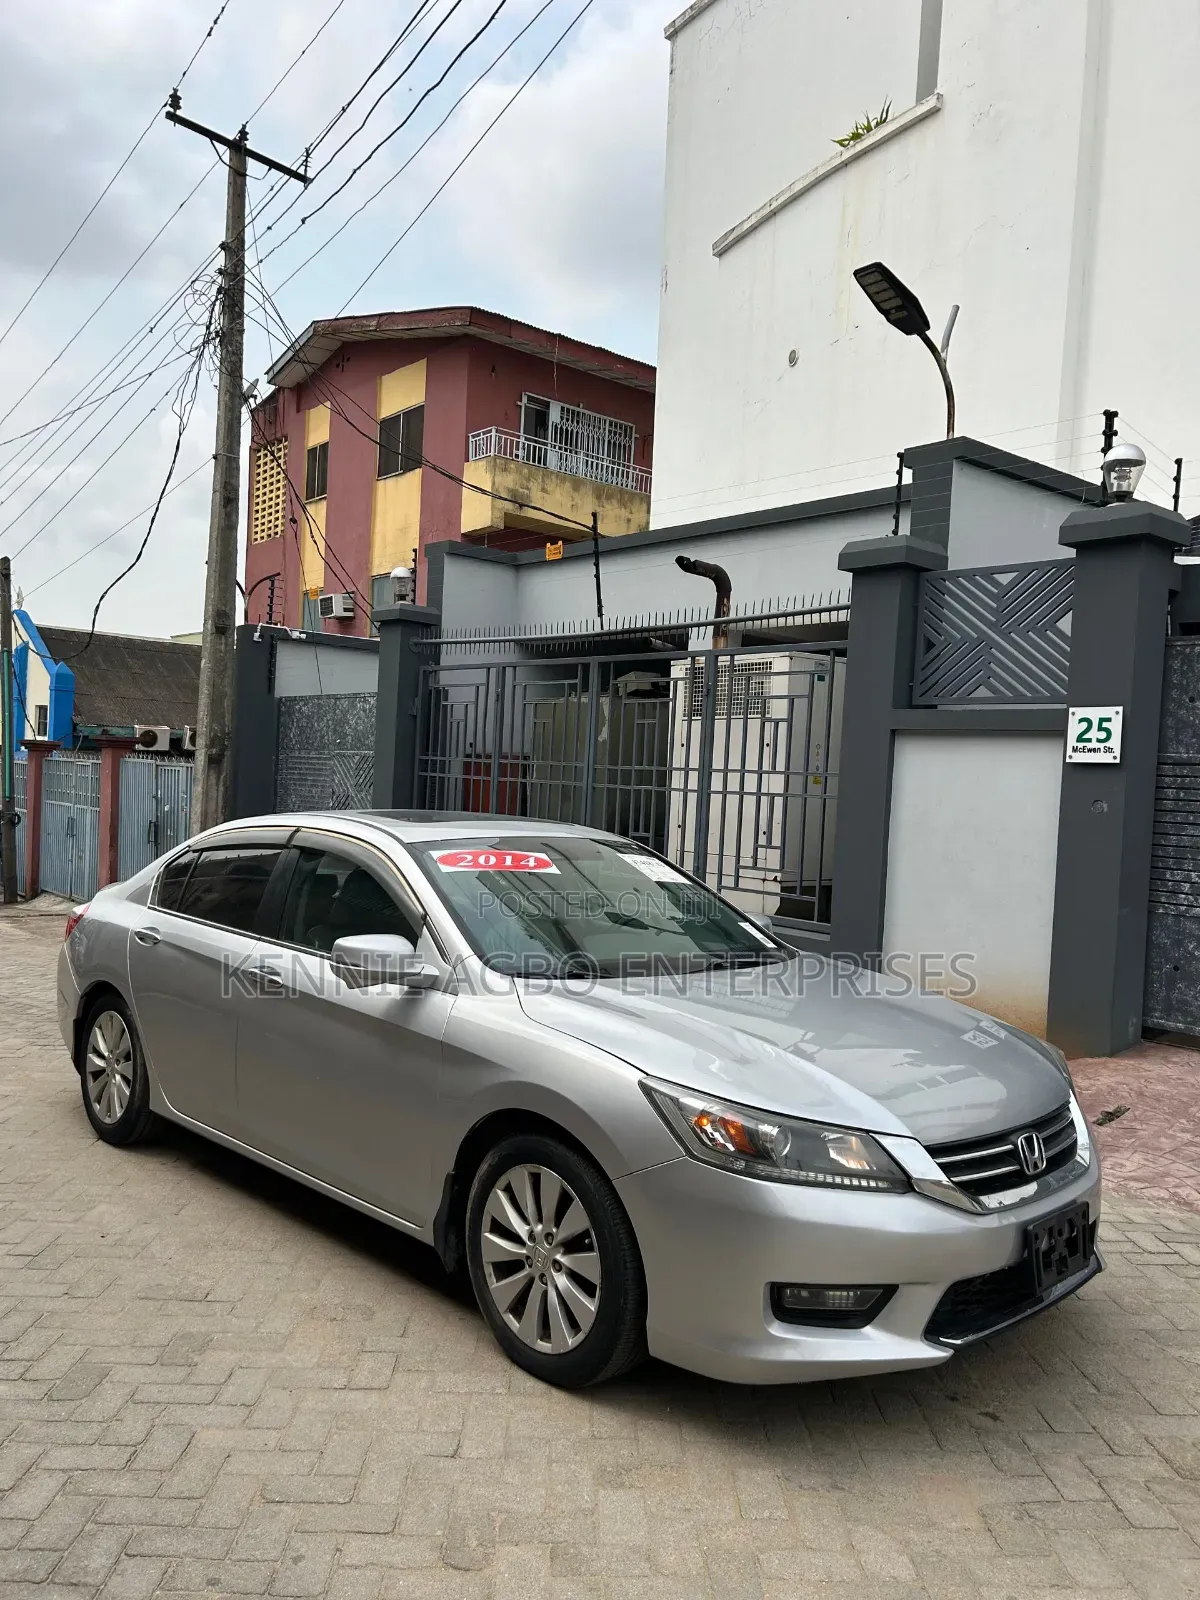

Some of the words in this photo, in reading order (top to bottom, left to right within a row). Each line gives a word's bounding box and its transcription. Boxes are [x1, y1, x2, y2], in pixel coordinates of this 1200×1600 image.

[1075, 716, 1113, 744] 25
[1072, 745, 1101, 753] McEwen
[1103, 745, 1115, 753] Str.
[455, 853, 538, 868] 2014
